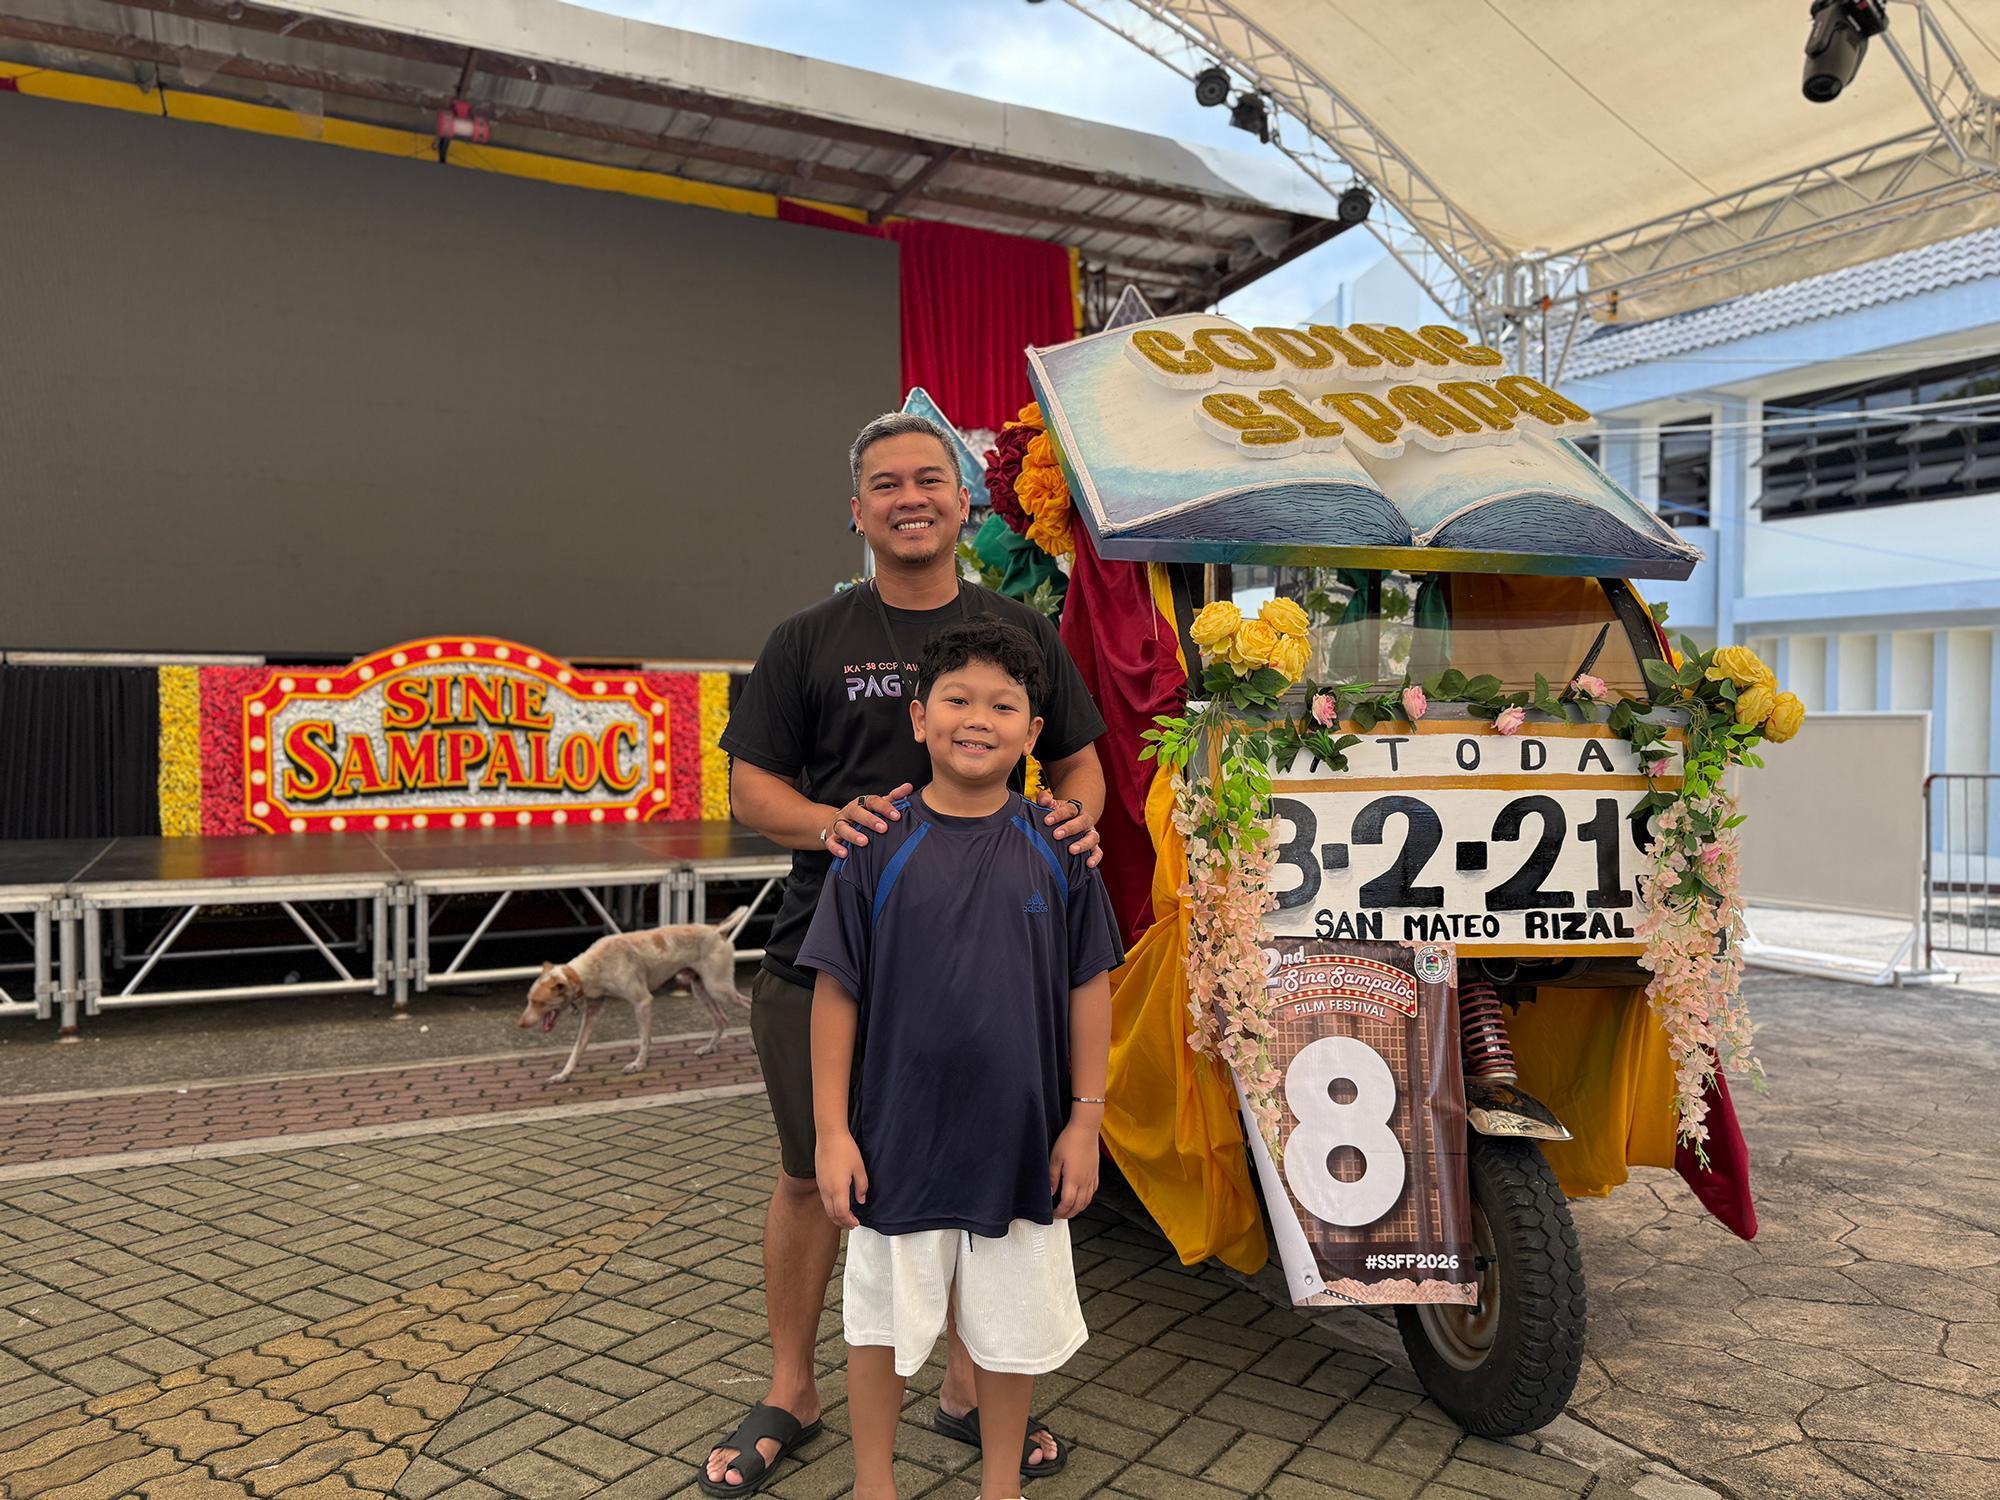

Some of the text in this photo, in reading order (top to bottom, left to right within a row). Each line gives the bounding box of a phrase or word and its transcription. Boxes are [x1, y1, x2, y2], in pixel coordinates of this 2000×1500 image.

[1202, 374, 1592, 445] SI PAPA
[383, 674, 553, 730] SINE
[846, 674, 920, 701] PAG
[284, 719, 642, 800] SAMPALOC
[1309, 737, 1615, 772] TODA
[1314, 909, 1635, 941] SAN MATEO RIZAL
[1284, 968, 1327, 992] Sine
[1329, 965, 1415, 1001] Sampaloc
[1294, 999, 1387, 1019] FILM FESTIVAL
[1284, 1036, 1406, 1227] 8
[1365, 1253, 1460, 1270] #SSFF2026
